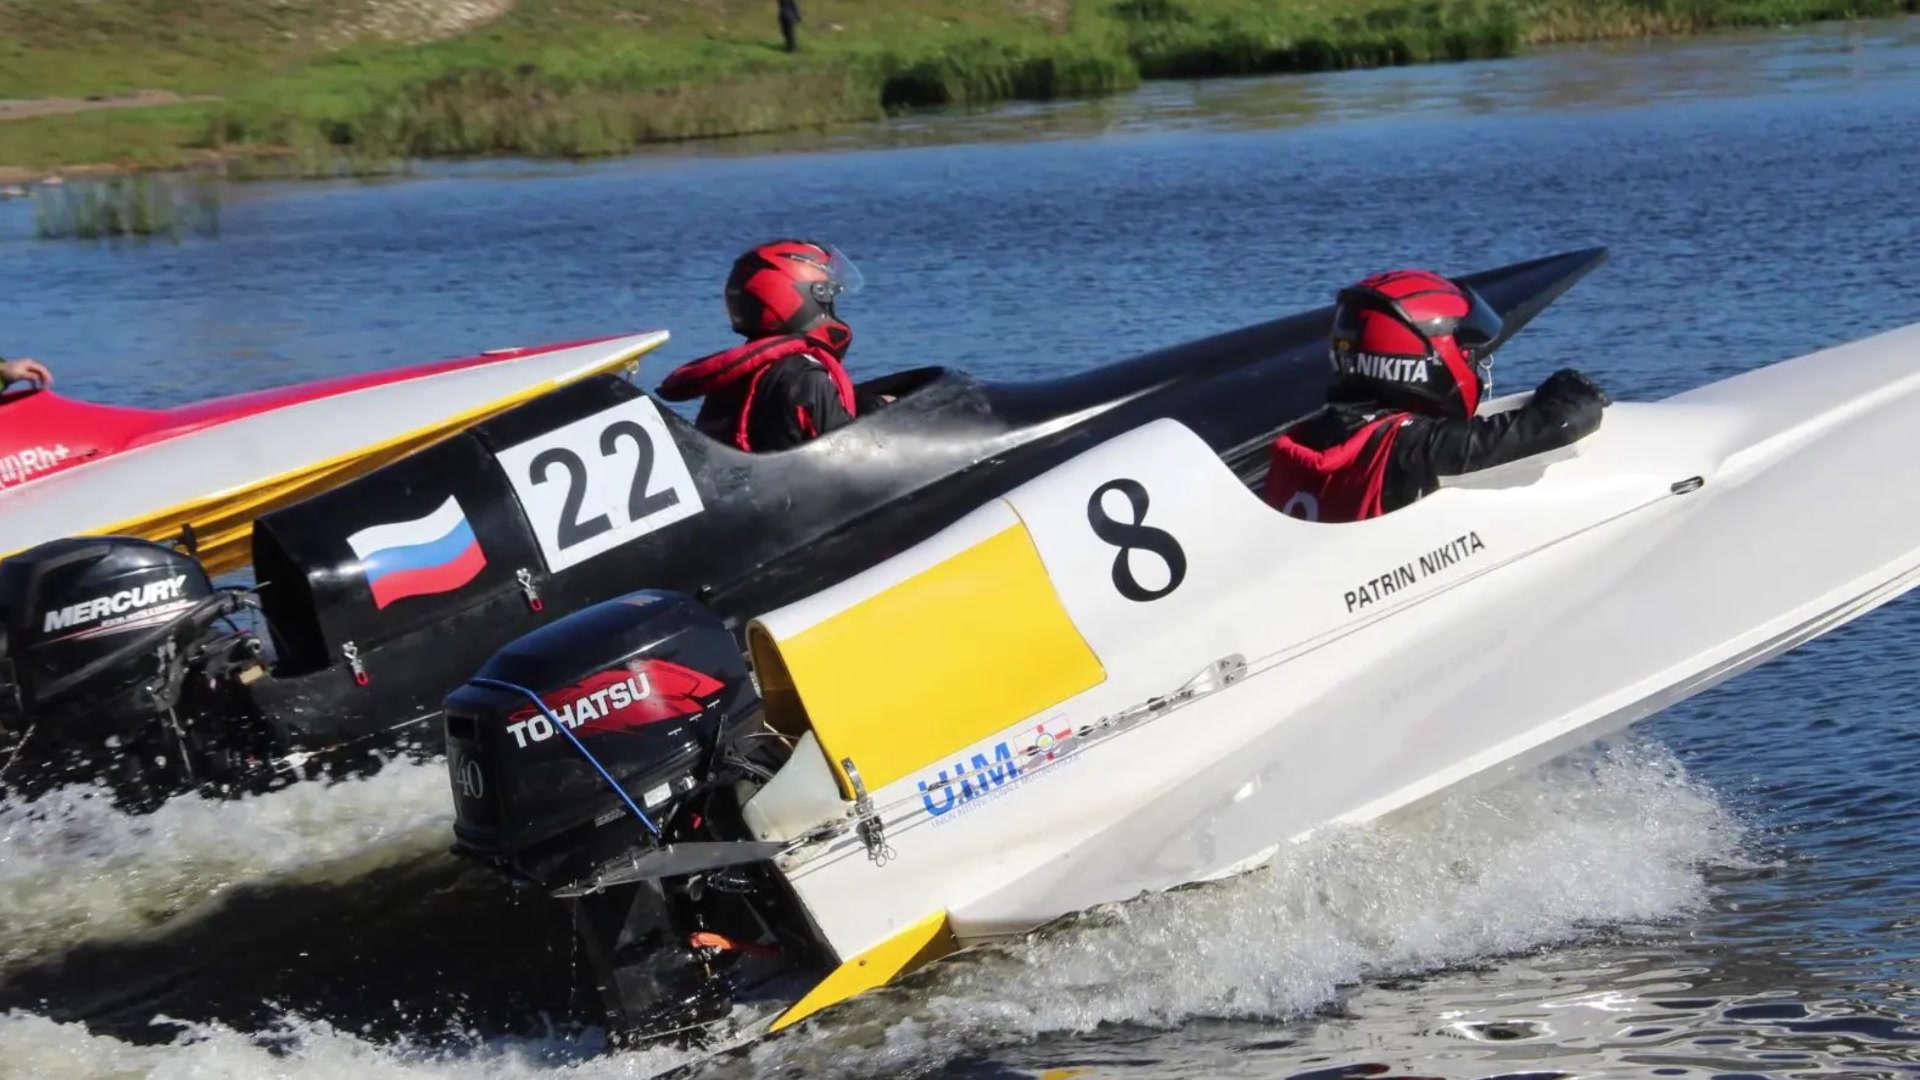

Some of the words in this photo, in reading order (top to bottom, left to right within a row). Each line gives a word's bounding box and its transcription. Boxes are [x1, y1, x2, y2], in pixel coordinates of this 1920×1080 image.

[529, 420, 681, 551] 22
[1087, 478, 1187, 602] 8
[1344, 562, 1416, 613] PATRIN
[1418, 530, 1485, 578] NIKITA
[44, 574, 187, 632] MERCURY
[507, 672, 651, 748] TOHATSU
[455, 754, 484, 799] 40
